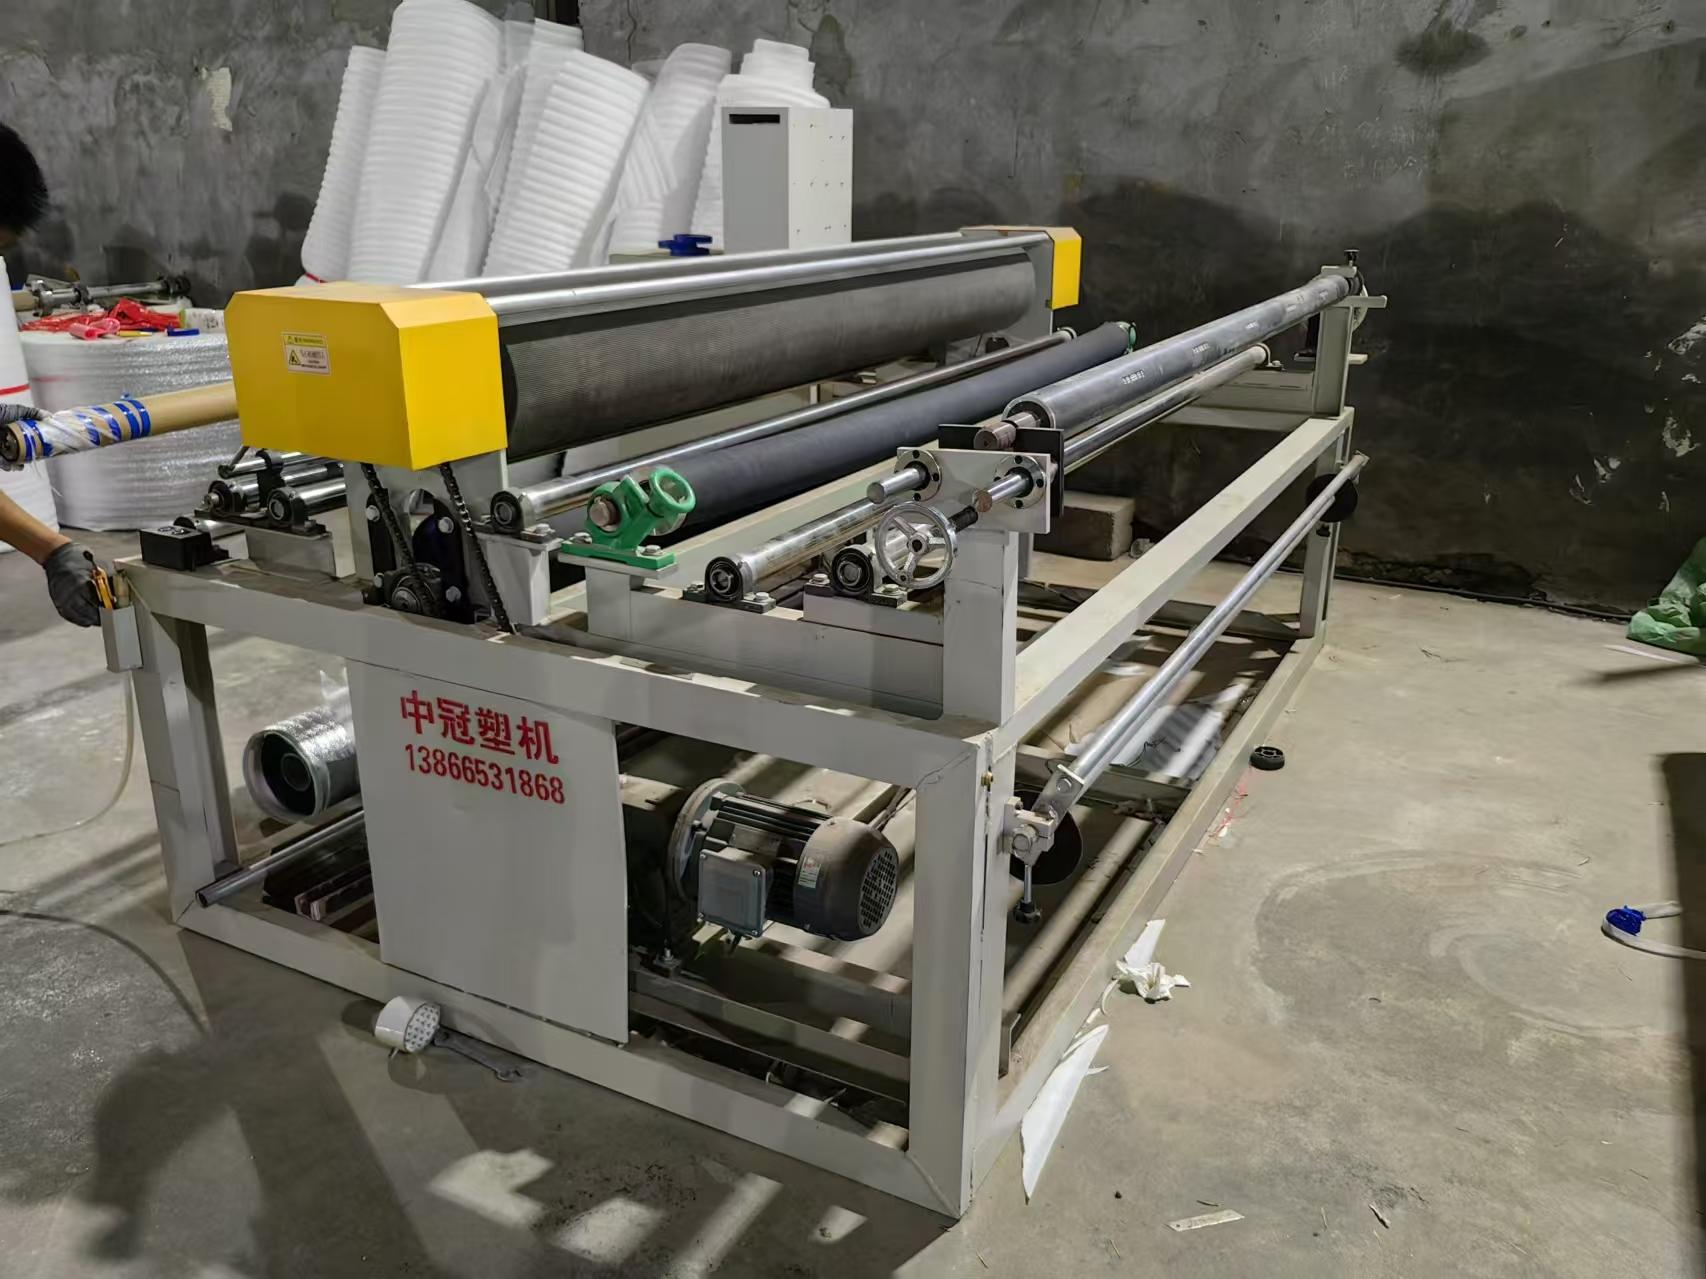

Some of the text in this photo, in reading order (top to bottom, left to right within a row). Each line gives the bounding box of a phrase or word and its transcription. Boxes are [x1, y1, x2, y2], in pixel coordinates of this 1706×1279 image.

[400, 690, 559, 764] 中冠塑机
[405, 744, 565, 804] 13866531868
